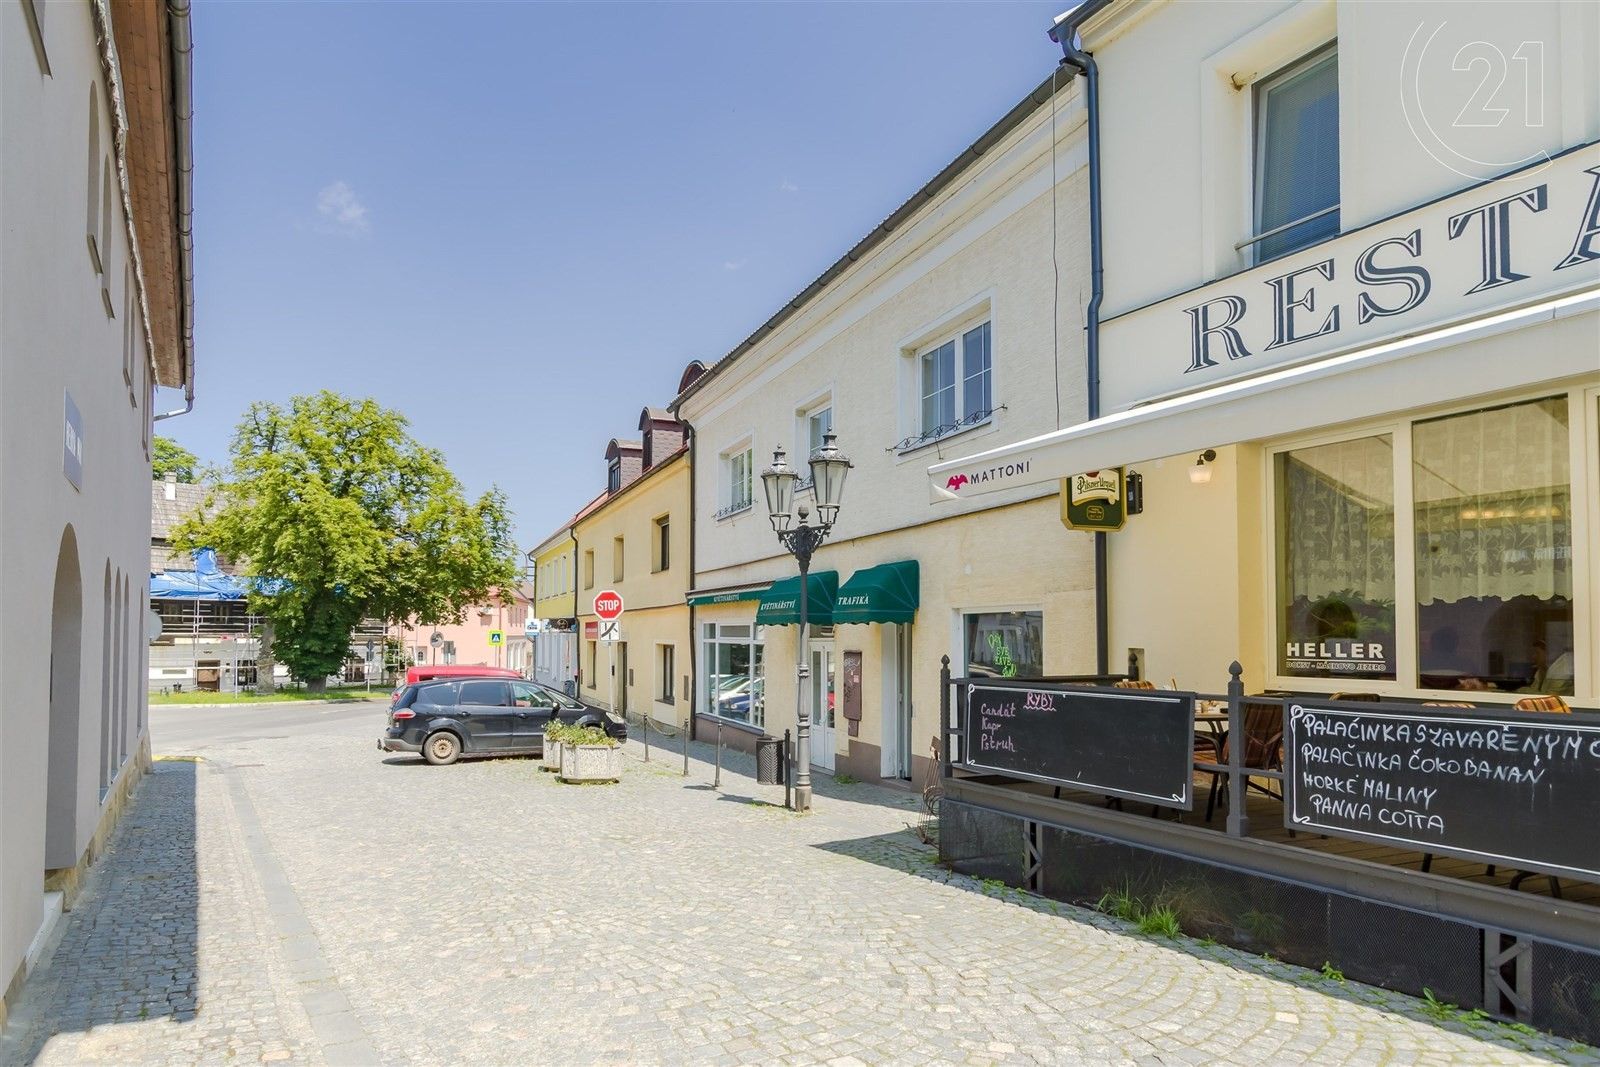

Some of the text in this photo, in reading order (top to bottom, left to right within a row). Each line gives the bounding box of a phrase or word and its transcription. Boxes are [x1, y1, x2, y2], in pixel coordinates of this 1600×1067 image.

[970, 461, 1030, 485] MATTONI
[598, 600, 620, 611] STOP
[1286, 642, 1384, 659] HELLER
[981, 702, 1016, 717] Candát
[1027, 692, 1054, 708] RYBY
[981, 716, 1001, 735] Kapr
[981, 733, 1017, 752] Pstruh
[1363, 778, 1437, 810] MALINY
[1309, 793, 1445, 835] PANNA COTTA
